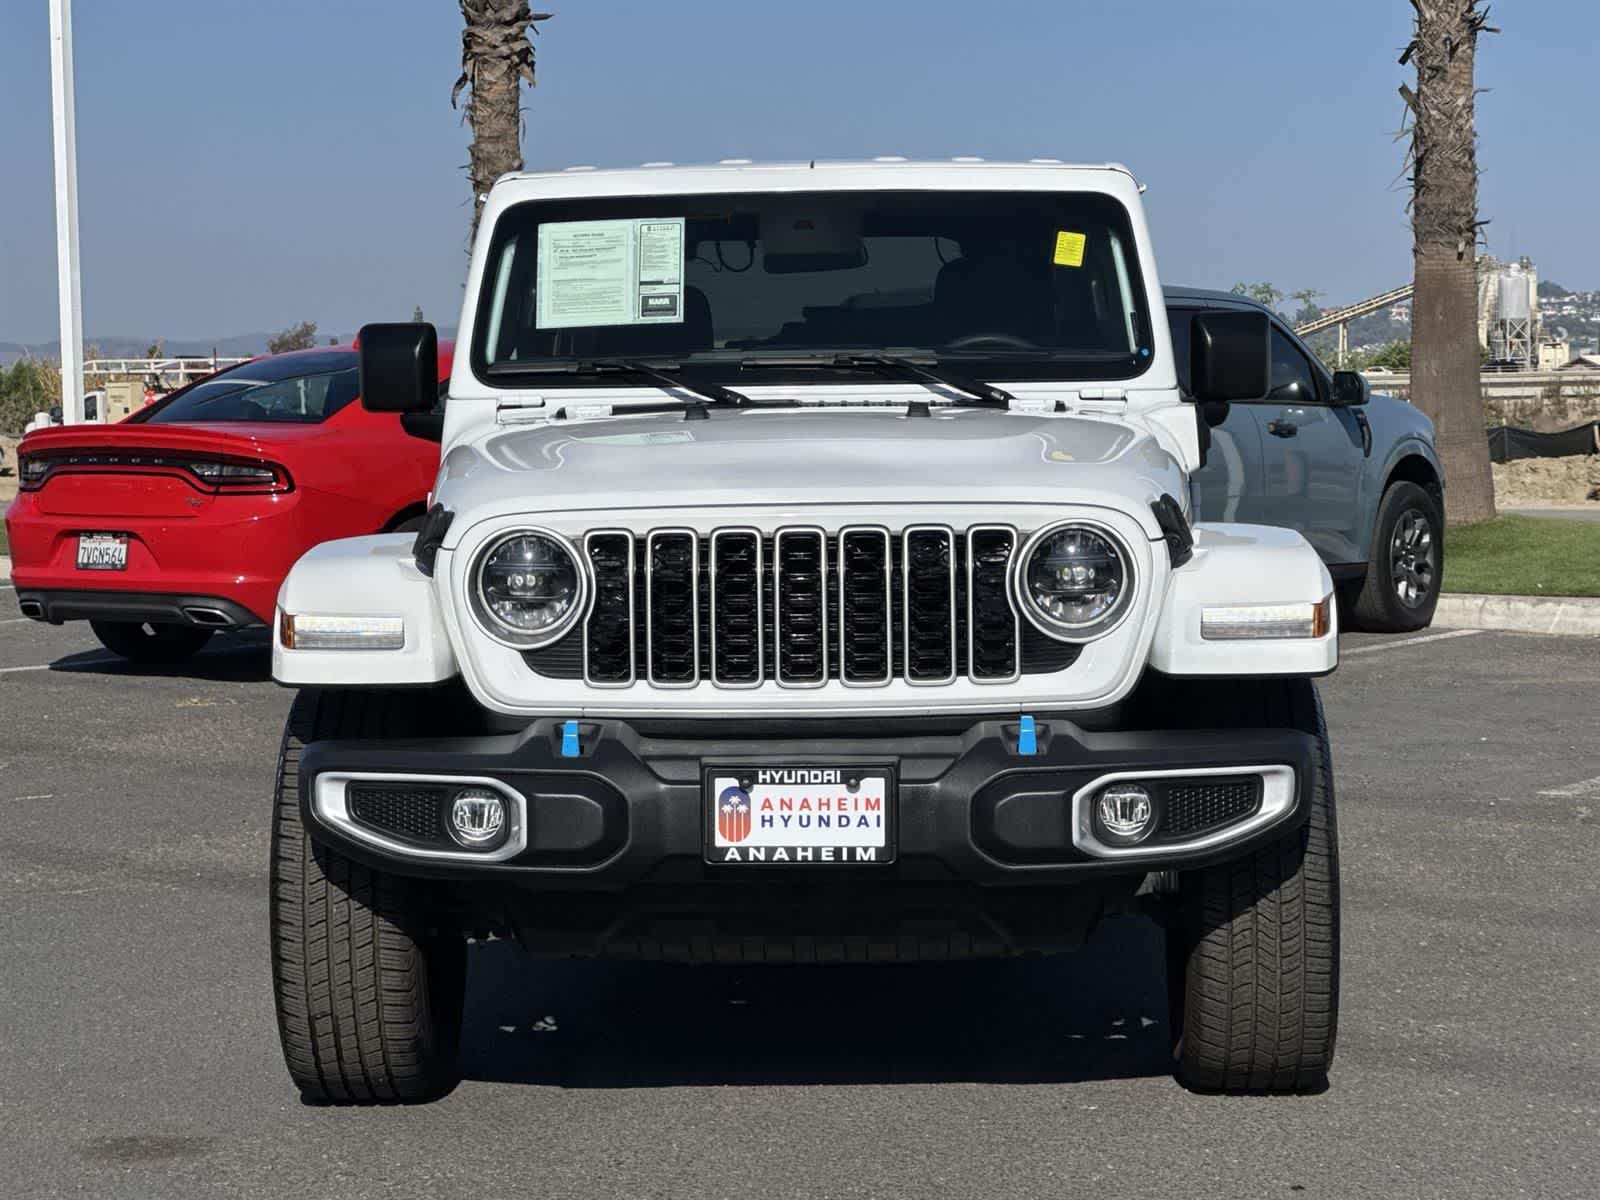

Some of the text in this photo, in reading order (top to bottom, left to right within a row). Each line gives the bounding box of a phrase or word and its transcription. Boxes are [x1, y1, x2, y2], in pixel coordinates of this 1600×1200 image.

[81, 546, 123, 562] 7VGN564
[758, 770, 841, 784] HYUNDAI
[760, 797, 881, 811] ANAHEIM
[760, 814, 881, 828] HYUNDAI
[724, 847, 876, 861] ANAHEIM
